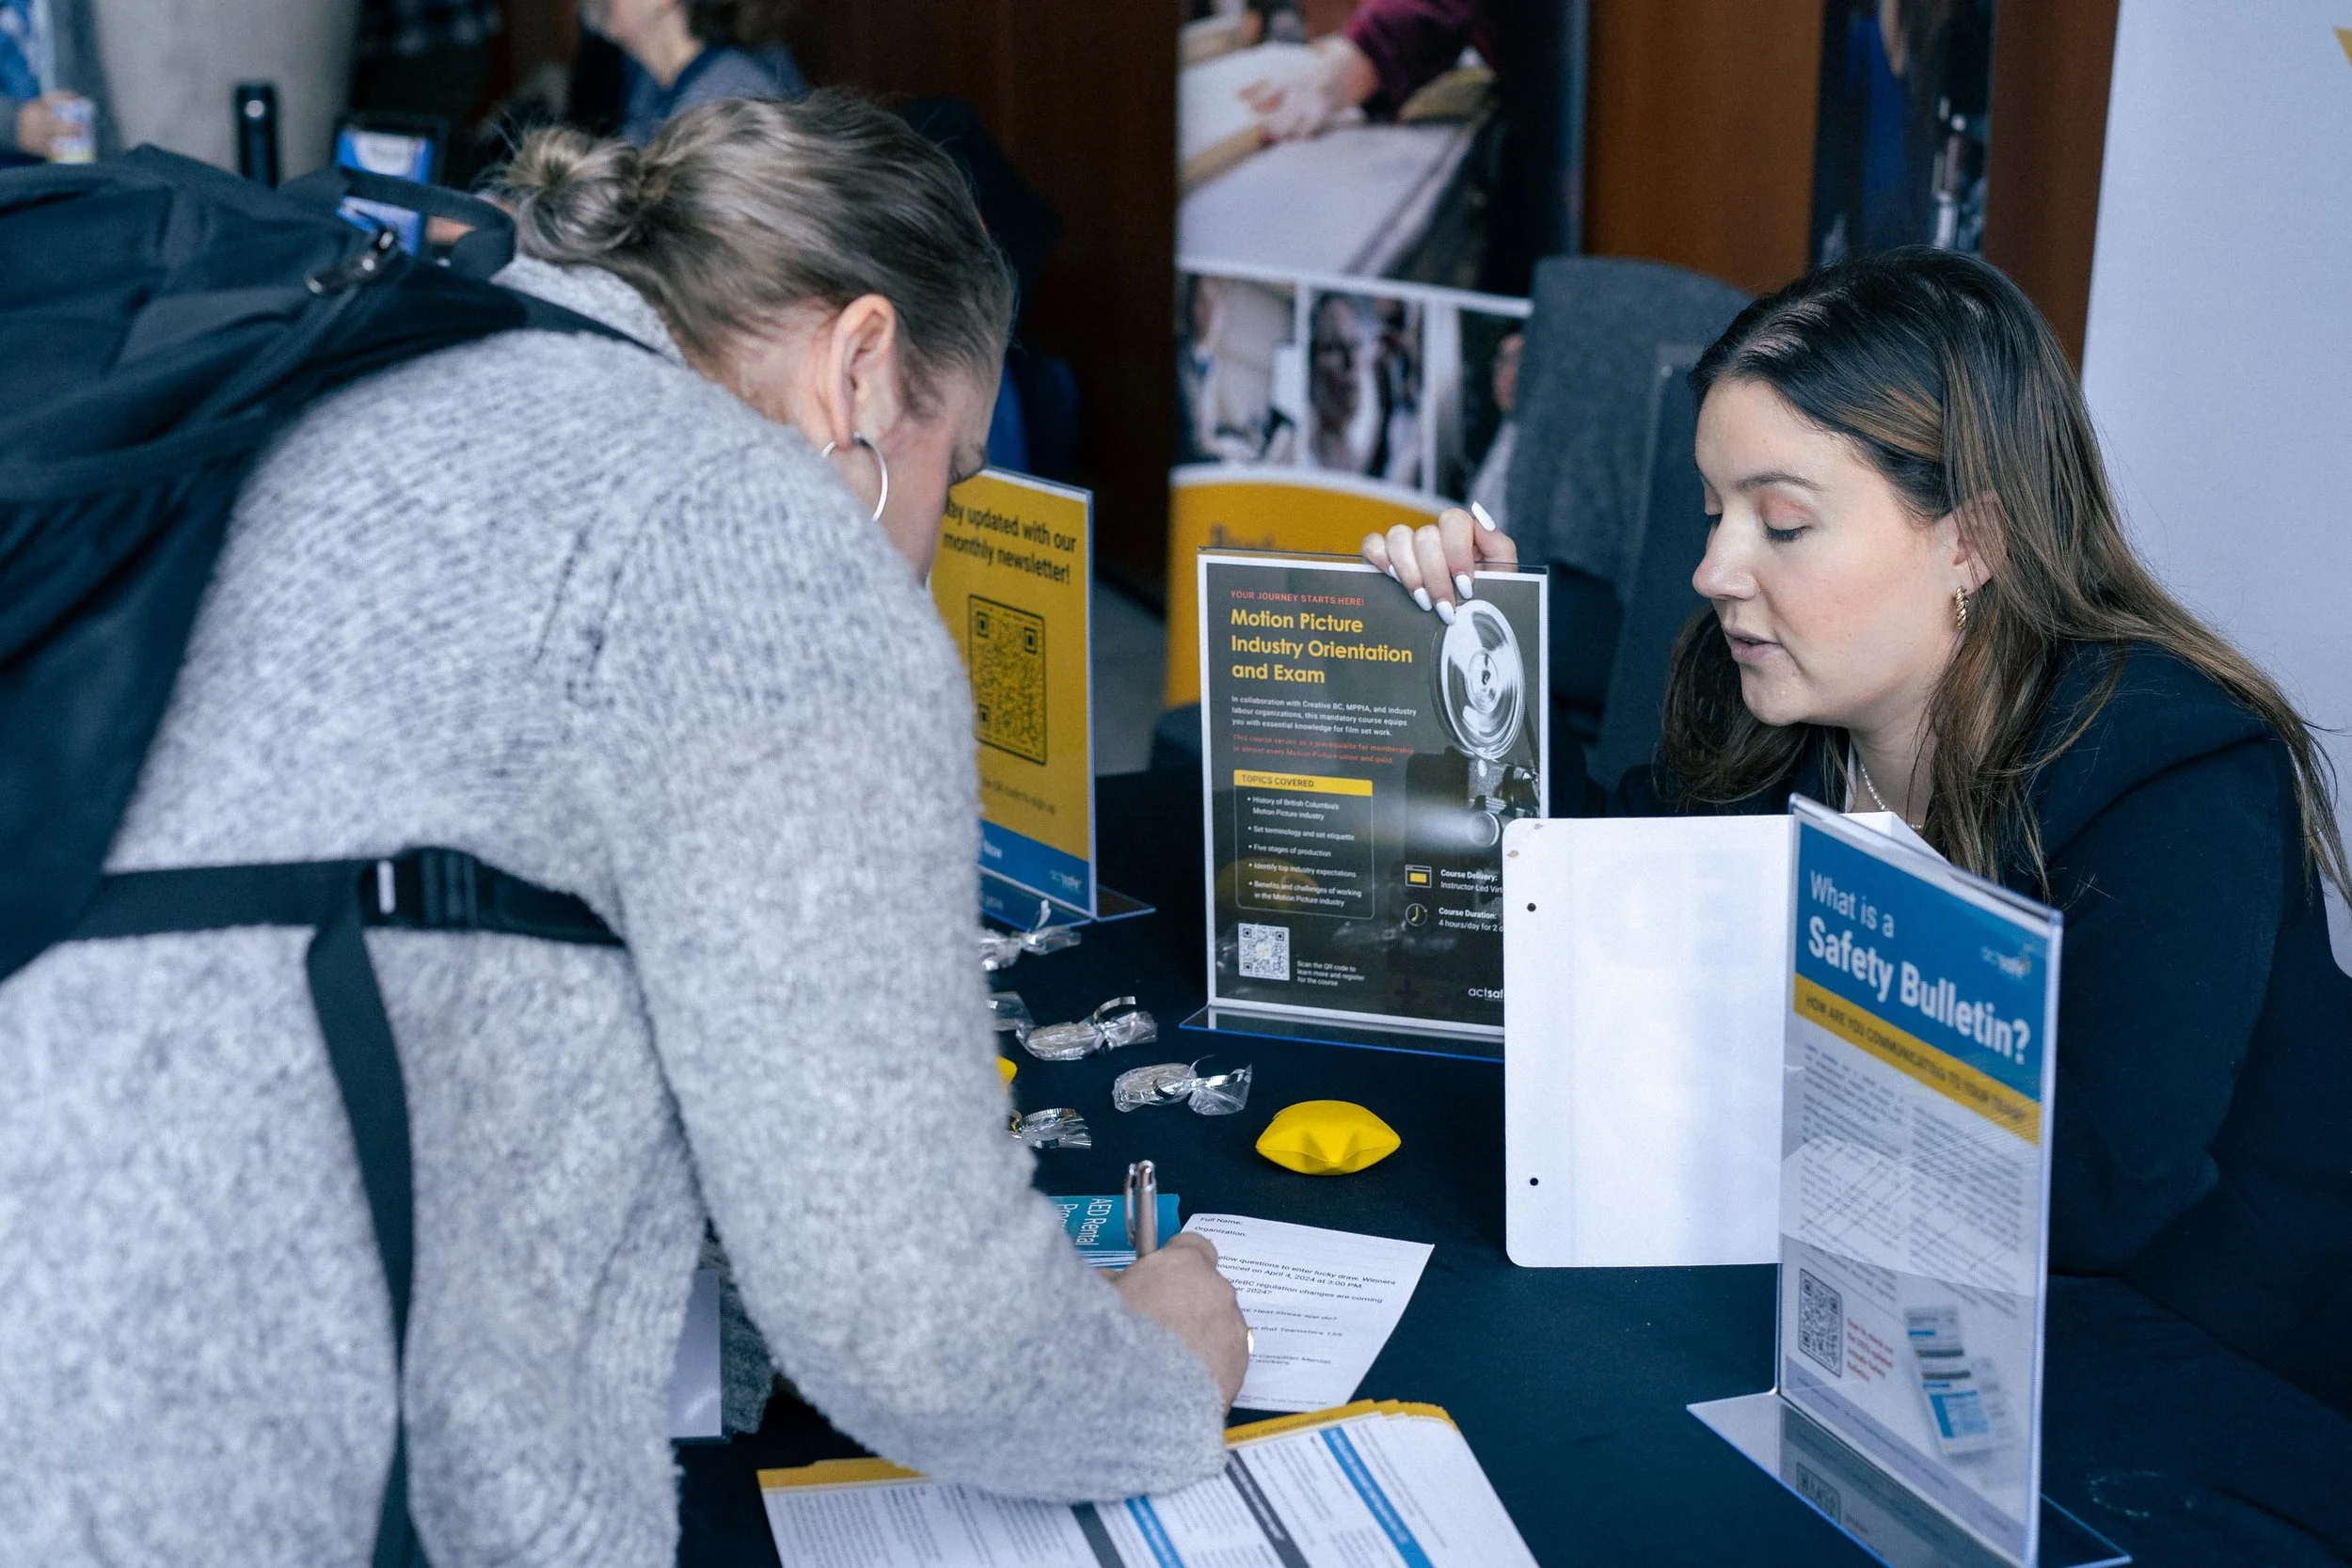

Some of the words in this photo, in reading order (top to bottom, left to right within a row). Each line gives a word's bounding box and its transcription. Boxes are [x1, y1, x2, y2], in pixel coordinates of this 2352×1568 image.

[967, 507, 1019, 537] updated
[1023, 520, 1051, 546] with
[1054, 532, 1076, 553] our
[943, 532, 994, 566] monthly
[997, 549, 1070, 584] newsletter!
[1231, 591, 1254, 600] YOUR
[1258, 593, 1298, 602] JOURNEY
[1300, 594, 1336, 605] STARTS
[1338, 596, 1364, 607] HERE!
[1231, 609, 1294, 629] Motion
[1299, 612, 1363, 633] Picture
[1232, 635, 1304, 659] Industry
[1308, 639, 1413, 663] Orientation
[1232, 663, 1268, 680] and
[1274, 664, 1326, 684] Exam
[1239, 696, 1285, 706] collaboration
[1302, 700, 1331, 710] Creative
[1332, 703, 1345, 711] BC,
[1346, 704, 1373, 713] MPPIA,
[1373, 705, 1387, 714] and
[1388, 707, 1417, 717] industry
[1232, 706, 1254, 715] labour
[1255, 708, 1303, 720] organizations,
[1304, 711, 1318, 720] this
[1319, 713, 1357, 724] mandatory
[1383, 718, 1407, 727] equips
[1262, 720, 1294, 730] essential
[1295, 722, 1332, 734] knowledge
[1344, 726, 1359, 735] film
[1373, 728, 1392, 736] work.
[1370, 744, 1415, 755] membership
[1241, 774, 1273, 784] TOPICS
[1274, 776, 1314, 787] COVERED
[1252, 796, 1275, 806] History
[1283, 799, 1304, 807] British
[1304, 800, 1340, 810] Columbia's
[1252, 807, 1275, 816] Motion
[1276, 808, 1298, 817] Picture
[1298, 811, 1325, 821] industry
[1264, 826, 1302, 837] terminology
[1327, 832, 1356, 841] etiquette
[1267, 846, 1289, 855] stages
[1297, 848, 1332, 858] production
[1253, 862, 1278, 872] Identify
[1278, 863, 1290, 873] top
[1290, 864, 1315, 876] industry
[1315, 867, 1357, 878] expectations
[1440, 869, 1467, 879] Course
[1467, 871, 1499, 882] Delivery:
[1253, 880, 1280, 889] Benefits
[1280, 881, 1294, 890] and
[1294, 882, 1327, 895] challenges
[1336, 888, 1362, 899] working
[1440, 880, 1489, 894] Instructor-Led
[1273, 893, 1295, 902] Motion
[1295, 895, 1318, 904] Picture
[1319, 896, 1345, 908] industry
[1810, 869, 1856, 920] What
[1860, 895, 1878, 930] is
[1882, 913, 1895, 939] a
[1438, 907, 1464, 917] Course
[1465, 909, 1498, 920] Duration:
[1444, 919, 1480, 932] hours/day
[1481, 923, 1492, 931] for
[1492, 924, 1499, 932] 2
[1296, 959, 1312, 968] Scan
[1342, 973, 1365, 981] register
[1808, 915, 1895, 1004] Safety
[1899, 959, 2031, 1066] Bulletin?
[1805, 995, 1827, 1014] HOW
[1828, 1006, 1846, 1025] ARE
[1847, 1016, 1866, 1037] YOU
[1087, 1197, 1114, 1217] AED
[1216, 1218, 1244, 1227] Name:
[1074, 1217, 1107, 1245] Rental
[1194, 1226, 1248, 1237] Organization:
[1239, 1258, 1279, 1270] questions
[1314, 1270, 1336, 1280] lucky
[1337, 1274, 1360, 1282] draw.
[1362, 1276, 1396, 1286] Winners
[1264, 1269, 1284, 1277] April
[1294, 1275, 1315, 1283] 2024
[1226, 1277, 1255, 1287] afeBC
[1256, 1280, 1297, 1293] regulation
[1299, 1289, 1335, 1300] changes
[1351, 1295, 1384, 1304] coming
[1279, 1327, 1324, 1336] Teamsters
